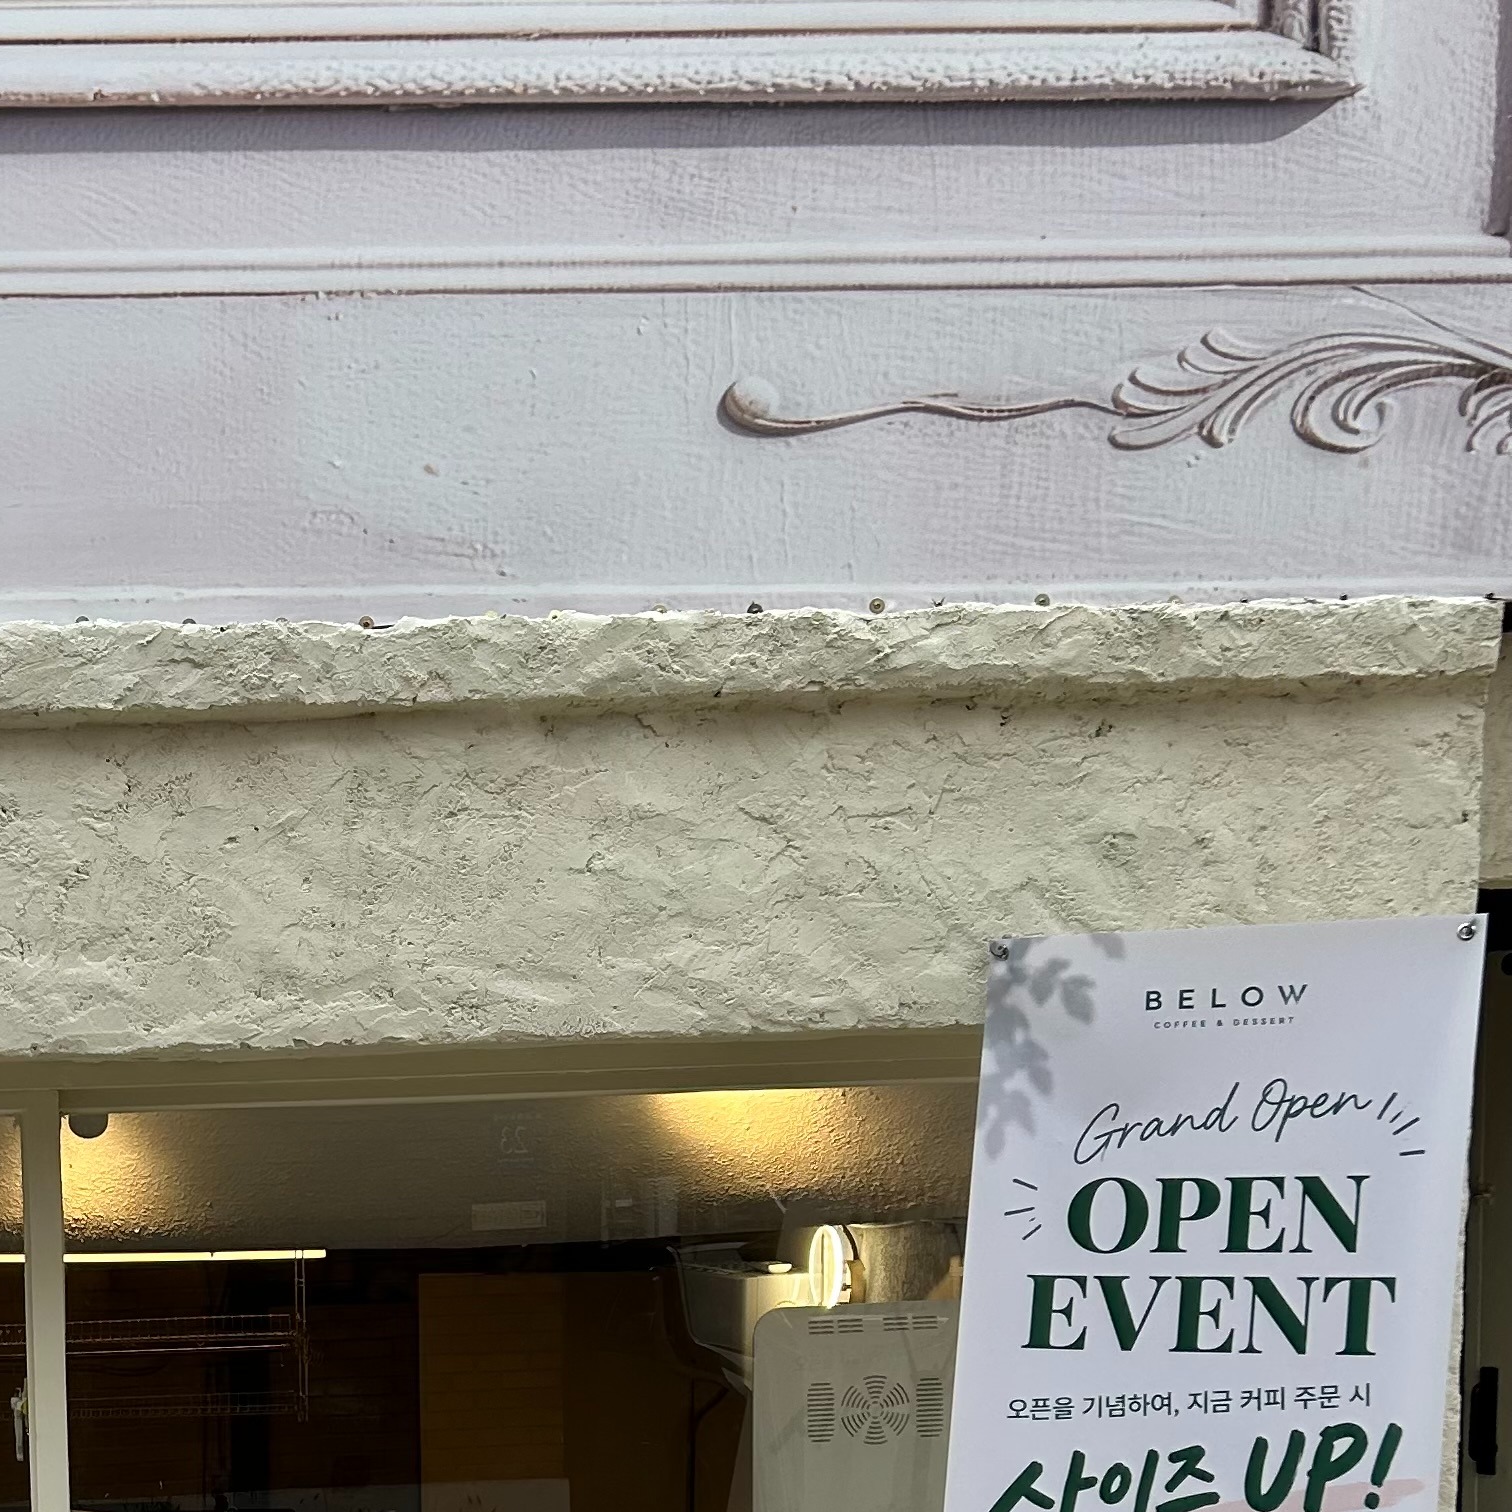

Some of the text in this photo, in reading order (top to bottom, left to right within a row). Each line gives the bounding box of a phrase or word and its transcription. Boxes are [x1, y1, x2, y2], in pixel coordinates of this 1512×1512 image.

[1145, 984, 1308, 1011] BELOW
[1153, 1016, 1295, 1029] COFFEE & DESSERT
[1073, 1077, 1372, 1165] Grand Open
[1066, 1174, 1370, 1255] OPEN
[1020, 1274, 1397, 1356] EVENT
[1006, 1382, 1371, 1421] 오픈을 기념하여, 지금 커피 주문 시
